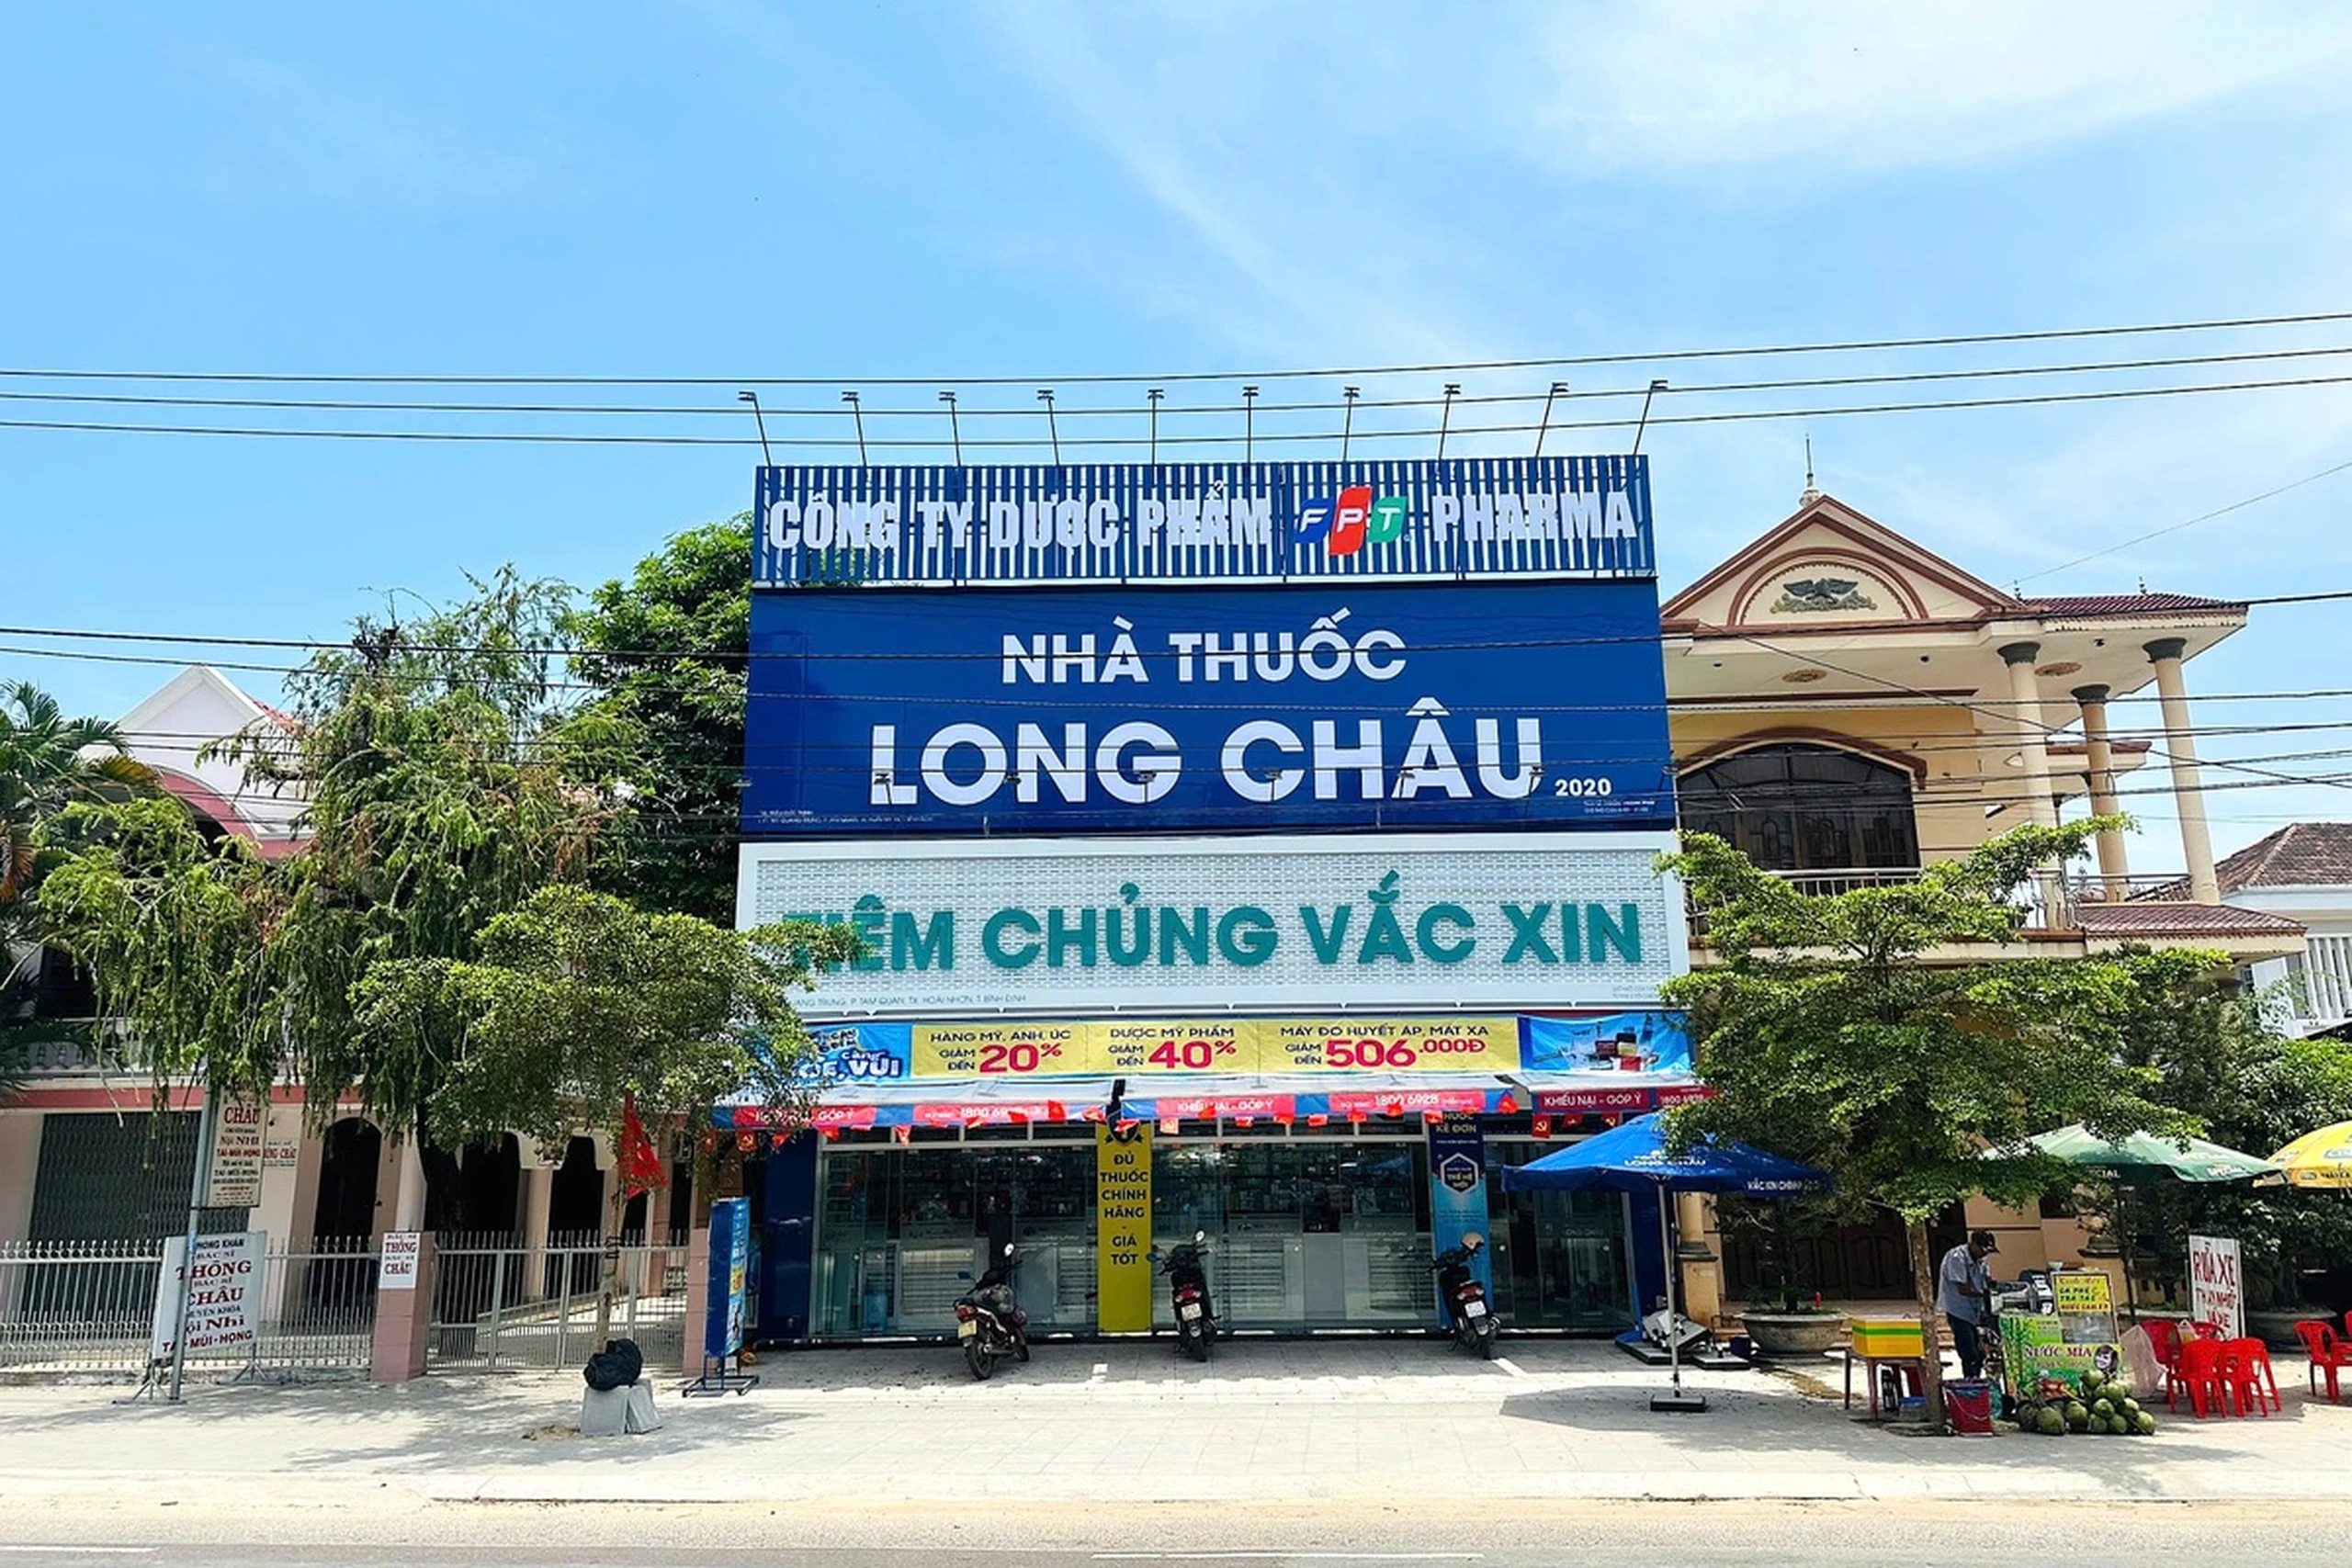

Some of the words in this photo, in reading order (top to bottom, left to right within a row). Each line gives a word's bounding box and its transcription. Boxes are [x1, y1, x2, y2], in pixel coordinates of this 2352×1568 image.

[769, 491, 899, 550] CÔNG
[917, 501, 974, 550] TY
[989, 492, 1120, 556] DƯỢC
[1136, 479, 1272, 547] PHẨM
[1431, 491, 1637, 543] PHARMA
[1001, 615, 1149, 683] NHÀ
[1168, 606, 1408, 682] THUỐC
[870, 720, 1182, 807] LONG
[1221, 696, 1544, 803] CHÂU
[1554, 777, 1612, 797] 2020
[982, 882, 1279, 969] CHỦNG
[1298, 869, 1476, 966] VẮC
[1500, 902, 1643, 964] XIN
[930, 1029, 977, 1043] HÀNG
[1049, 1028, 1072, 1041] ÚC
[1110, 1027, 1158, 1041] DƯỢC
[1159, 1026, 1187, 1039] MỸ
[1189, 1024, 1235, 1038] PHẨM
[1280, 1025, 1314, 1037] MÁY
[1318, 1026, 1343, 1036] ĐO
[1347, 1022, 1396, 1036] HUYẾT
[1466, 1026, 1489, 1036] XA
[939, 1047, 976, 1059] GIẢM
[1108, 1043, 1145, 1055] GIẢM
[1148, 1039, 1237, 1069] 40%
[1284, 1042, 1321, 1053] GIẢM
[947, 1059, 976, 1071] ĐẾN
[979, 1043, 1063, 1074] 20%
[1116, 1055, 1144, 1066] ĐẾN
[1295, 1055, 1321, 1066] ĐẾN
[848, 1057, 900, 1077] VUI
[1544, 1090, 1576, 1106] KHIẾU
[1577, 1094, 1597, 1109] NẠI
[1606, 1092, 1633, 1104] GÓP
[1634, 1092, 1643, 1104] Ý
[1114, 1150, 1135, 1166] ĐỦ
[1100, 1168, 1148, 1183] THUỐC
[1102, 1187, 1147, 1201] CHÍNH
[1104, 1205, 1146, 1218] HÃNG
[1112, 1234, 1137, 1247] GIÁ
[1111, 1248, 1139, 1266] TỐT
[205, 1314, 245, 1331] Nhi
